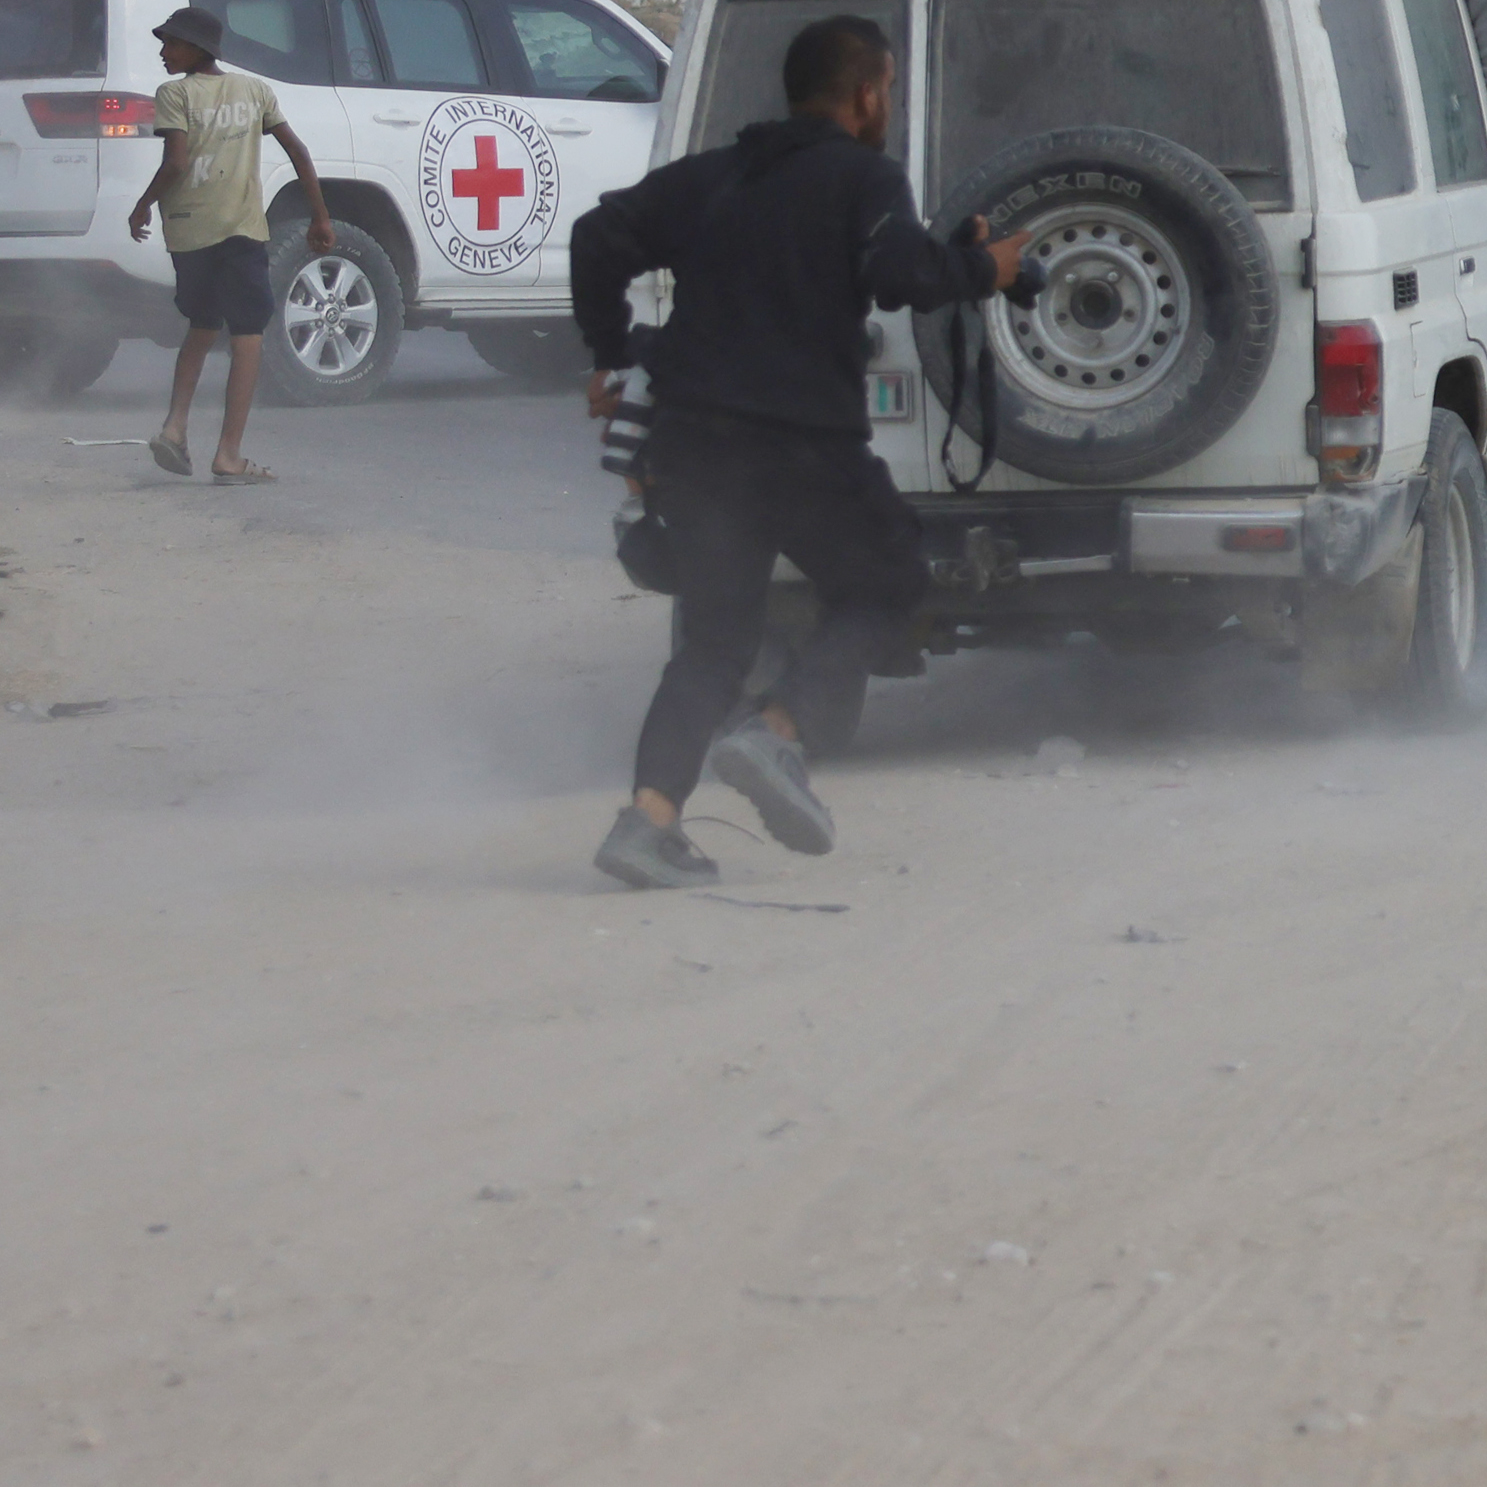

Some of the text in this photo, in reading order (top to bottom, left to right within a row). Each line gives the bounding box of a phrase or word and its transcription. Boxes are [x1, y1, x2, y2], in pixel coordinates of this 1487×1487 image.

[424, 100, 555, 228] COMITE INTERNATIONAL
[986, 171, 1142, 227] NEXEN
[448, 234, 528, 269] GENEVE
